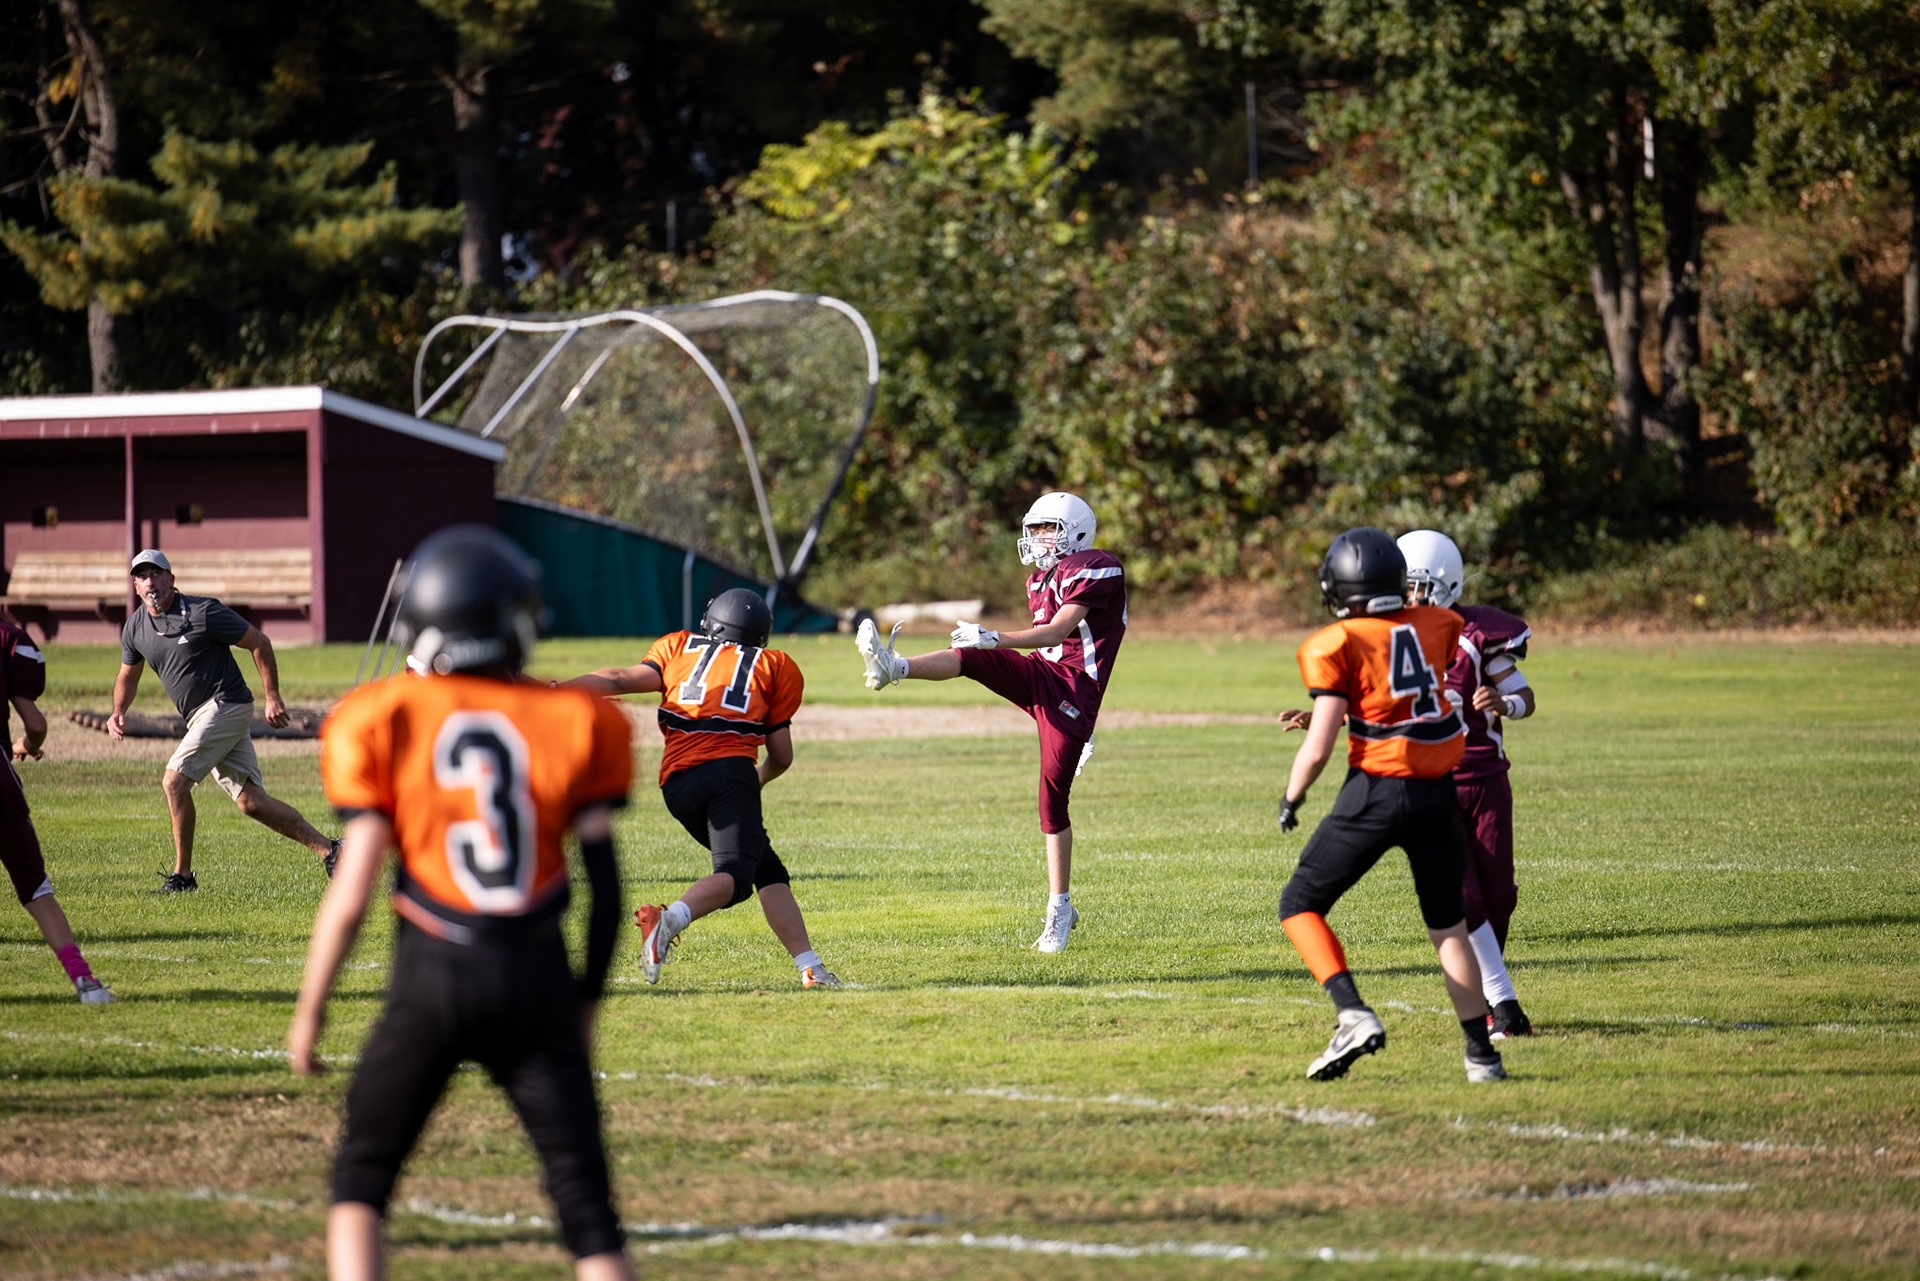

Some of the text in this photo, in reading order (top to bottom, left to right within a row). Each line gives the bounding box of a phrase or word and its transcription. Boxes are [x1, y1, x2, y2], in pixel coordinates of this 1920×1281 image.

[677, 634, 763, 714] 71
[1388, 623, 1442, 718] 4
[433, 709, 538, 913] 3
